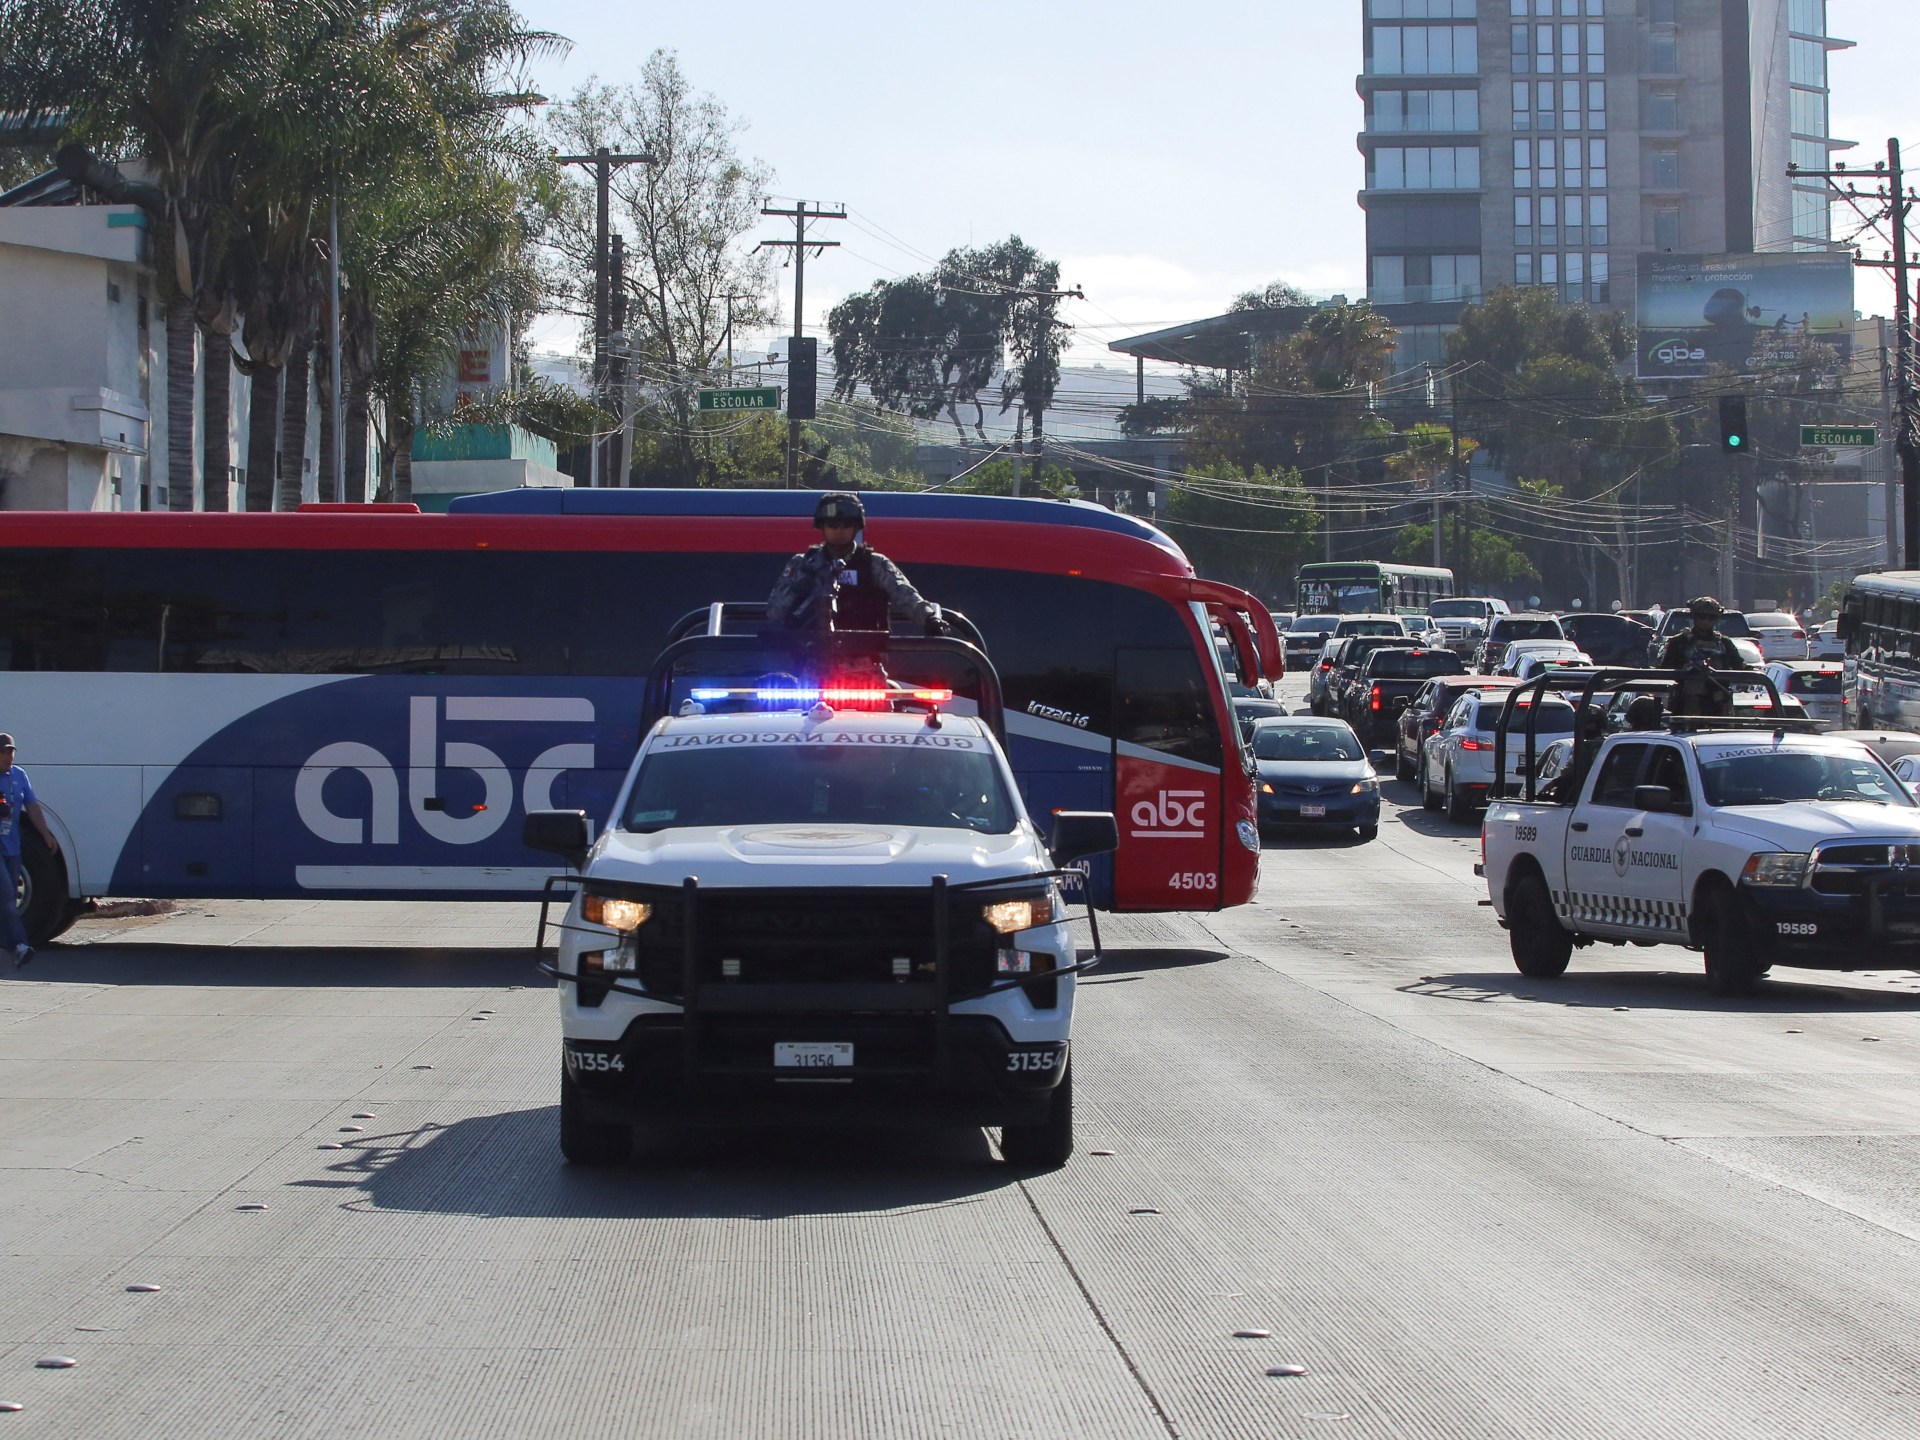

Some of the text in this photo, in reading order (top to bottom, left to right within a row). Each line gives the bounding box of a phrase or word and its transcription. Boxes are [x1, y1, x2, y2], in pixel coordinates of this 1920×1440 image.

[1704, 271, 1753, 283] protección
[1658, 346, 1705, 363] gba
[1779, 351, 1794, 359] 788
[713, 396, 764, 408] ESCOLAR
[1814, 434, 1862, 444] ESCOLAR
[1309, 596, 1328, 606] BETA
[295, 696, 595, 845] abc
[1131, 790, 1205, 827] abc
[1514, 825, 1537, 842] 19589
[1571, 846, 1678, 870] GUARDIA NACIONAL
[1168, 872, 1217, 890] 4503
[1776, 922, 1818, 935] 19589
[569, 1050, 625, 1072] 31354
[794, 1054, 834, 1067] 31354
